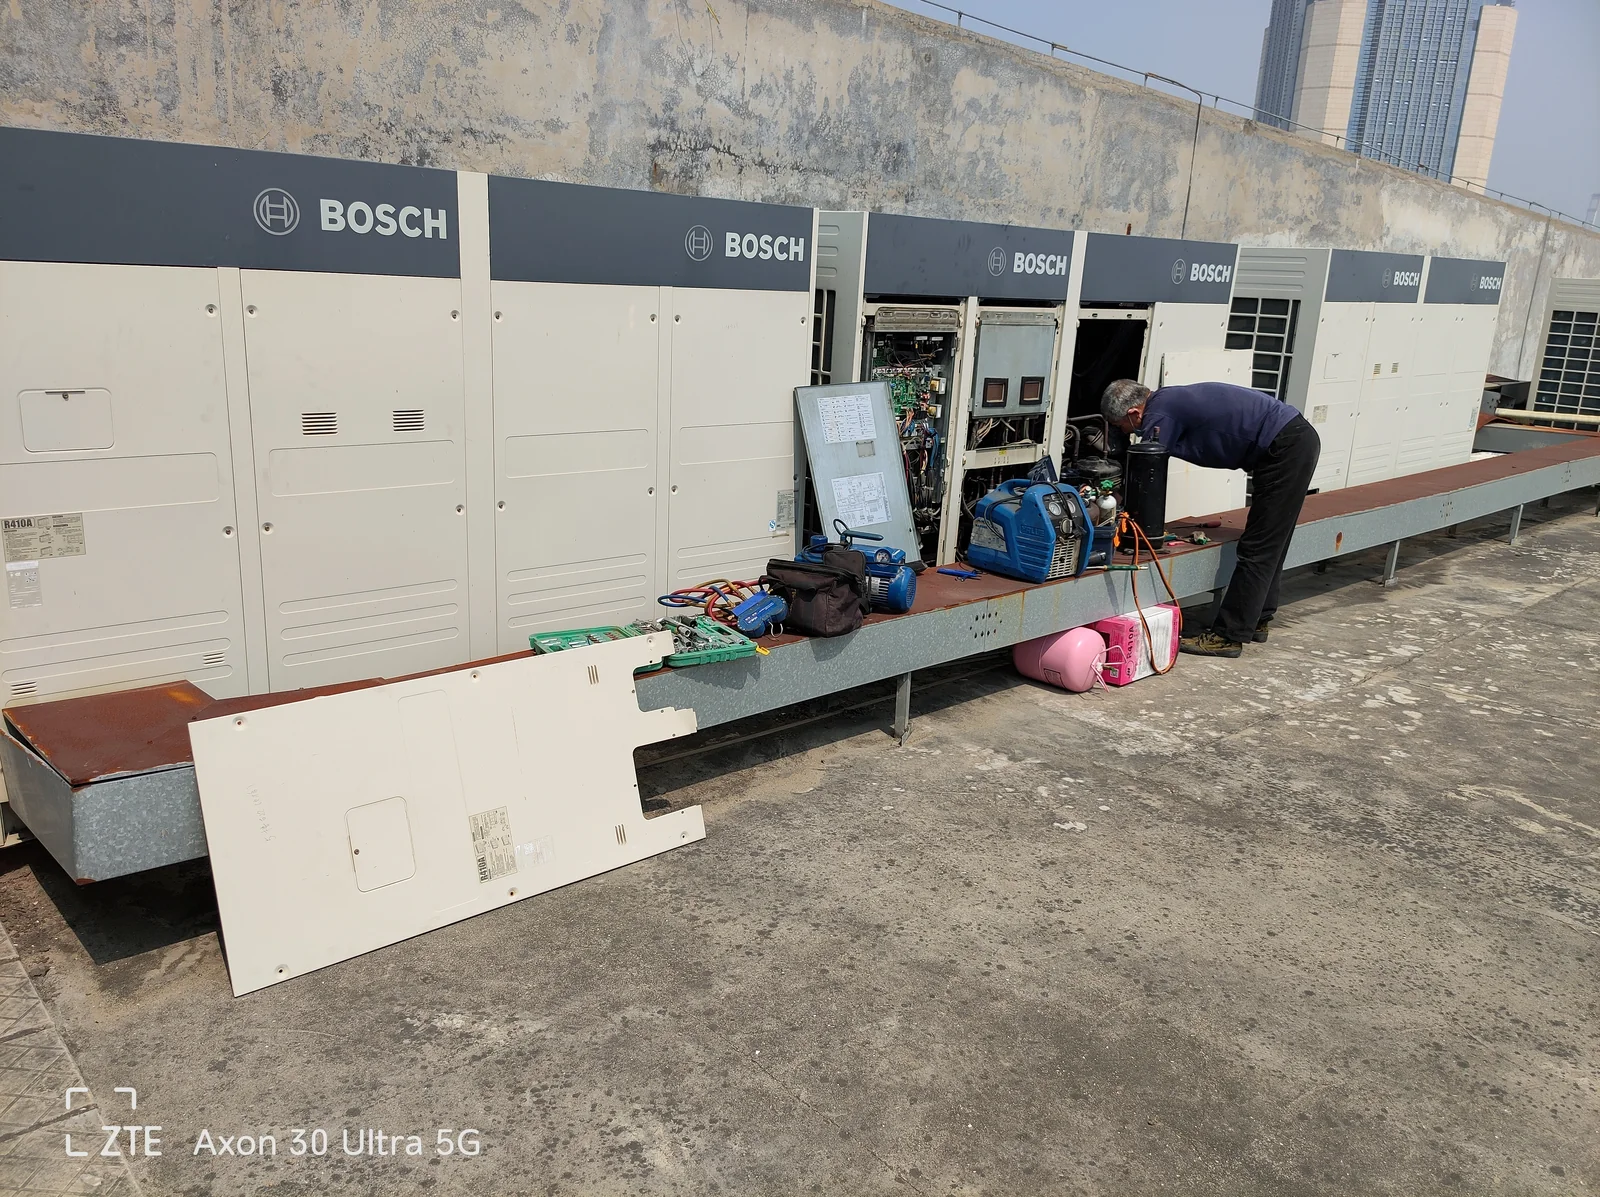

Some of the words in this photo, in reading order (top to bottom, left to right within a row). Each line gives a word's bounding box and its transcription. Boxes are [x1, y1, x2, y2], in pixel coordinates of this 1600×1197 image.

[320, 198, 447, 240] BOSCH
[725, 232, 805, 262] BOSCH
[1013, 252, 1067, 276] BOSCH
[1190, 263, 1232, 283] BOSCH
[1393, 271, 1420, 287] BOSCH
[1479, 276, 1502, 290] BOSCH
[4, 519, 32, 528] R410A
[1126, 625, 1135, 659] R410A
[478, 856, 488, 881] R410A
